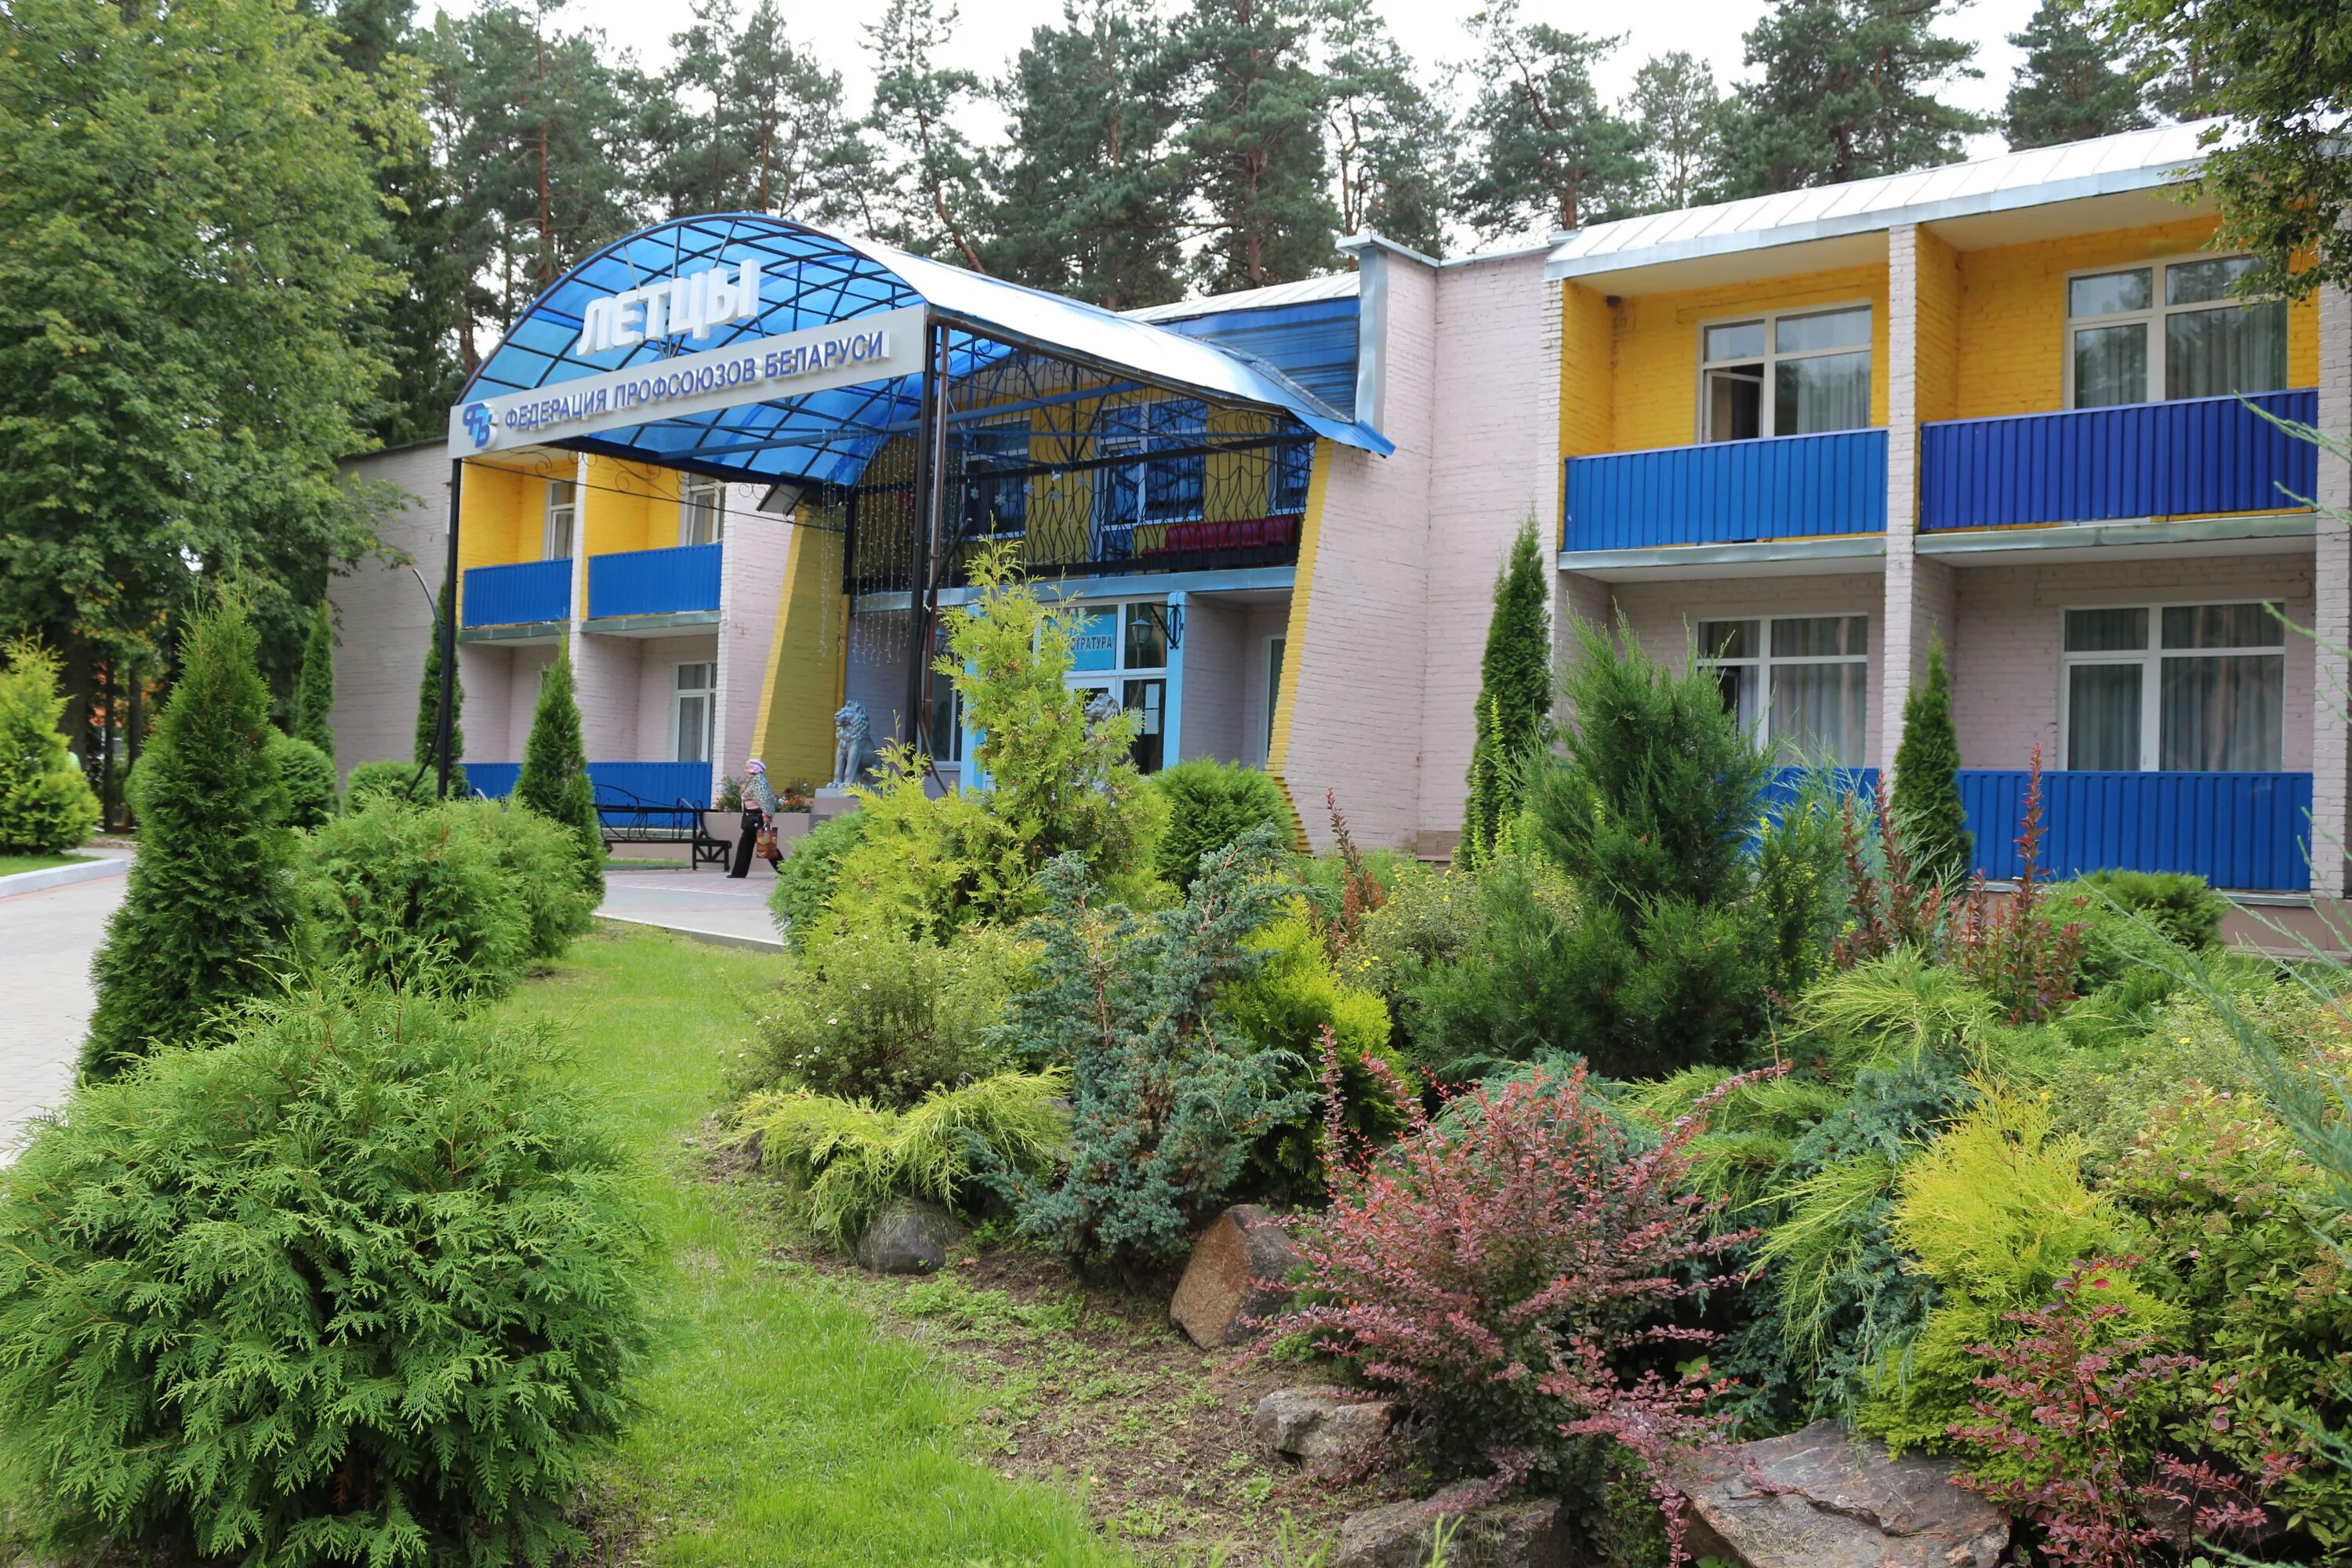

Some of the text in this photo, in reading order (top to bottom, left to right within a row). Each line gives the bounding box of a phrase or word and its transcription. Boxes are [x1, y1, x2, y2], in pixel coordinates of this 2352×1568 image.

[576, 259, 760, 356] ЛЕТЦЫ
[505, 331, 884, 429] ФЕДЕРАЦИЯ ПРОФСОЮЗОВ БЕЛАРУСИ
[1069, 636, 1112, 651] СТРАТУРА
